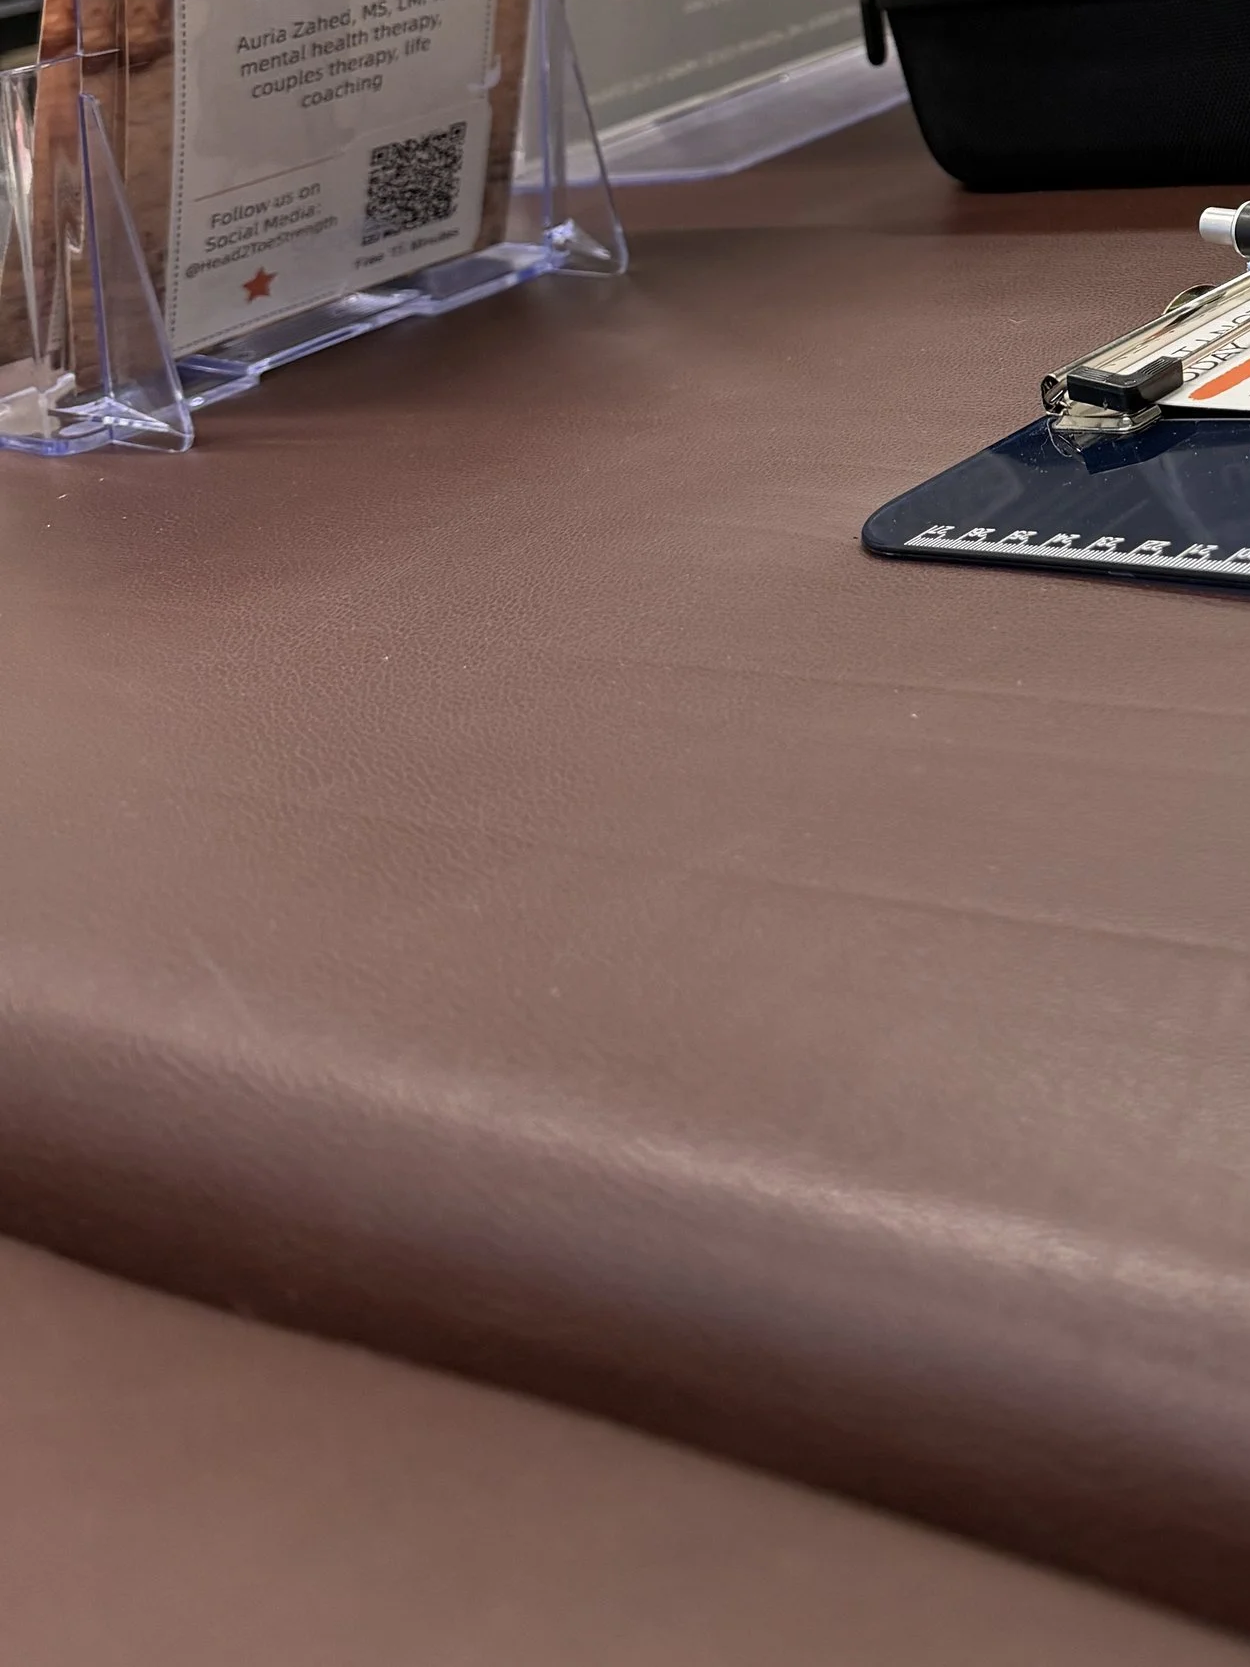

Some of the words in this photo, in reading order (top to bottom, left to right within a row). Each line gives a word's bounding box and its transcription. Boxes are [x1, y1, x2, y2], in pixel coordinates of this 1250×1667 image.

[236, 28, 287, 54] Auria
[293, 12, 356, 40] Zahed,
[362, 0, 392, 21] MS,
[240, 47, 306, 77] mental
[312, 29, 369, 56] health
[374, 14, 442, 43] therapy,
[252, 69, 323, 100] couples
[329, 48, 399, 77] therapy,
[405, 34, 431, 56] life
[301, 74, 383, 108] coaching
[205, 222, 259, 253] Social
[263, 203, 321, 233] Media:
[211, 199, 269, 228] Follow
[275, 191, 294, 207] us
[299, 182, 321, 201] on
[1183, 340, 1249, 383] ODAY
